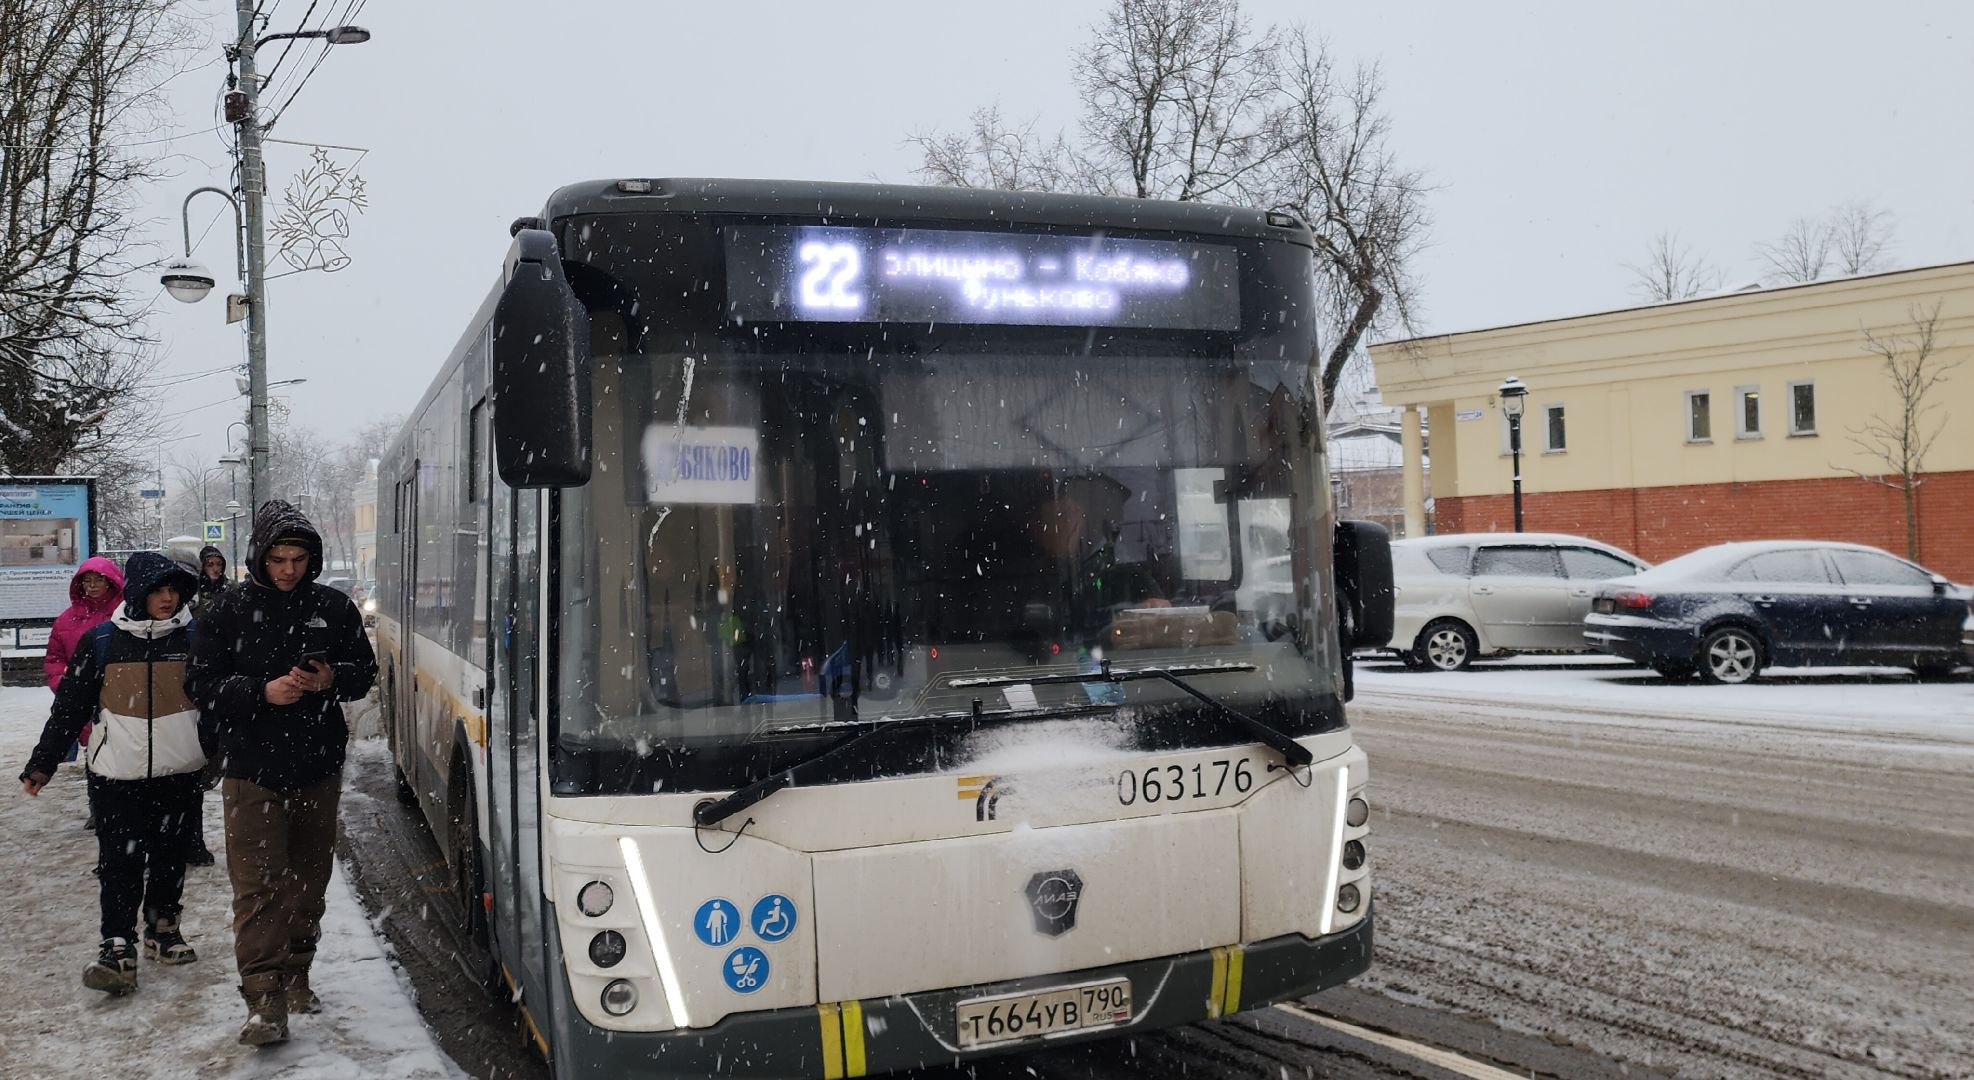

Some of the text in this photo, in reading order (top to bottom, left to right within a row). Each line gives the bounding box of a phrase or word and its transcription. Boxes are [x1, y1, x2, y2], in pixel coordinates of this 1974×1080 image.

[800, 243, 859, 307] 22
[657, 444, 751, 481] БЯКОВО
[1117, 757, 1253, 806] 063176
[969, 986, 1123, 1040] Т664УВ 790
[1093, 1011, 1112, 1022] RUS
